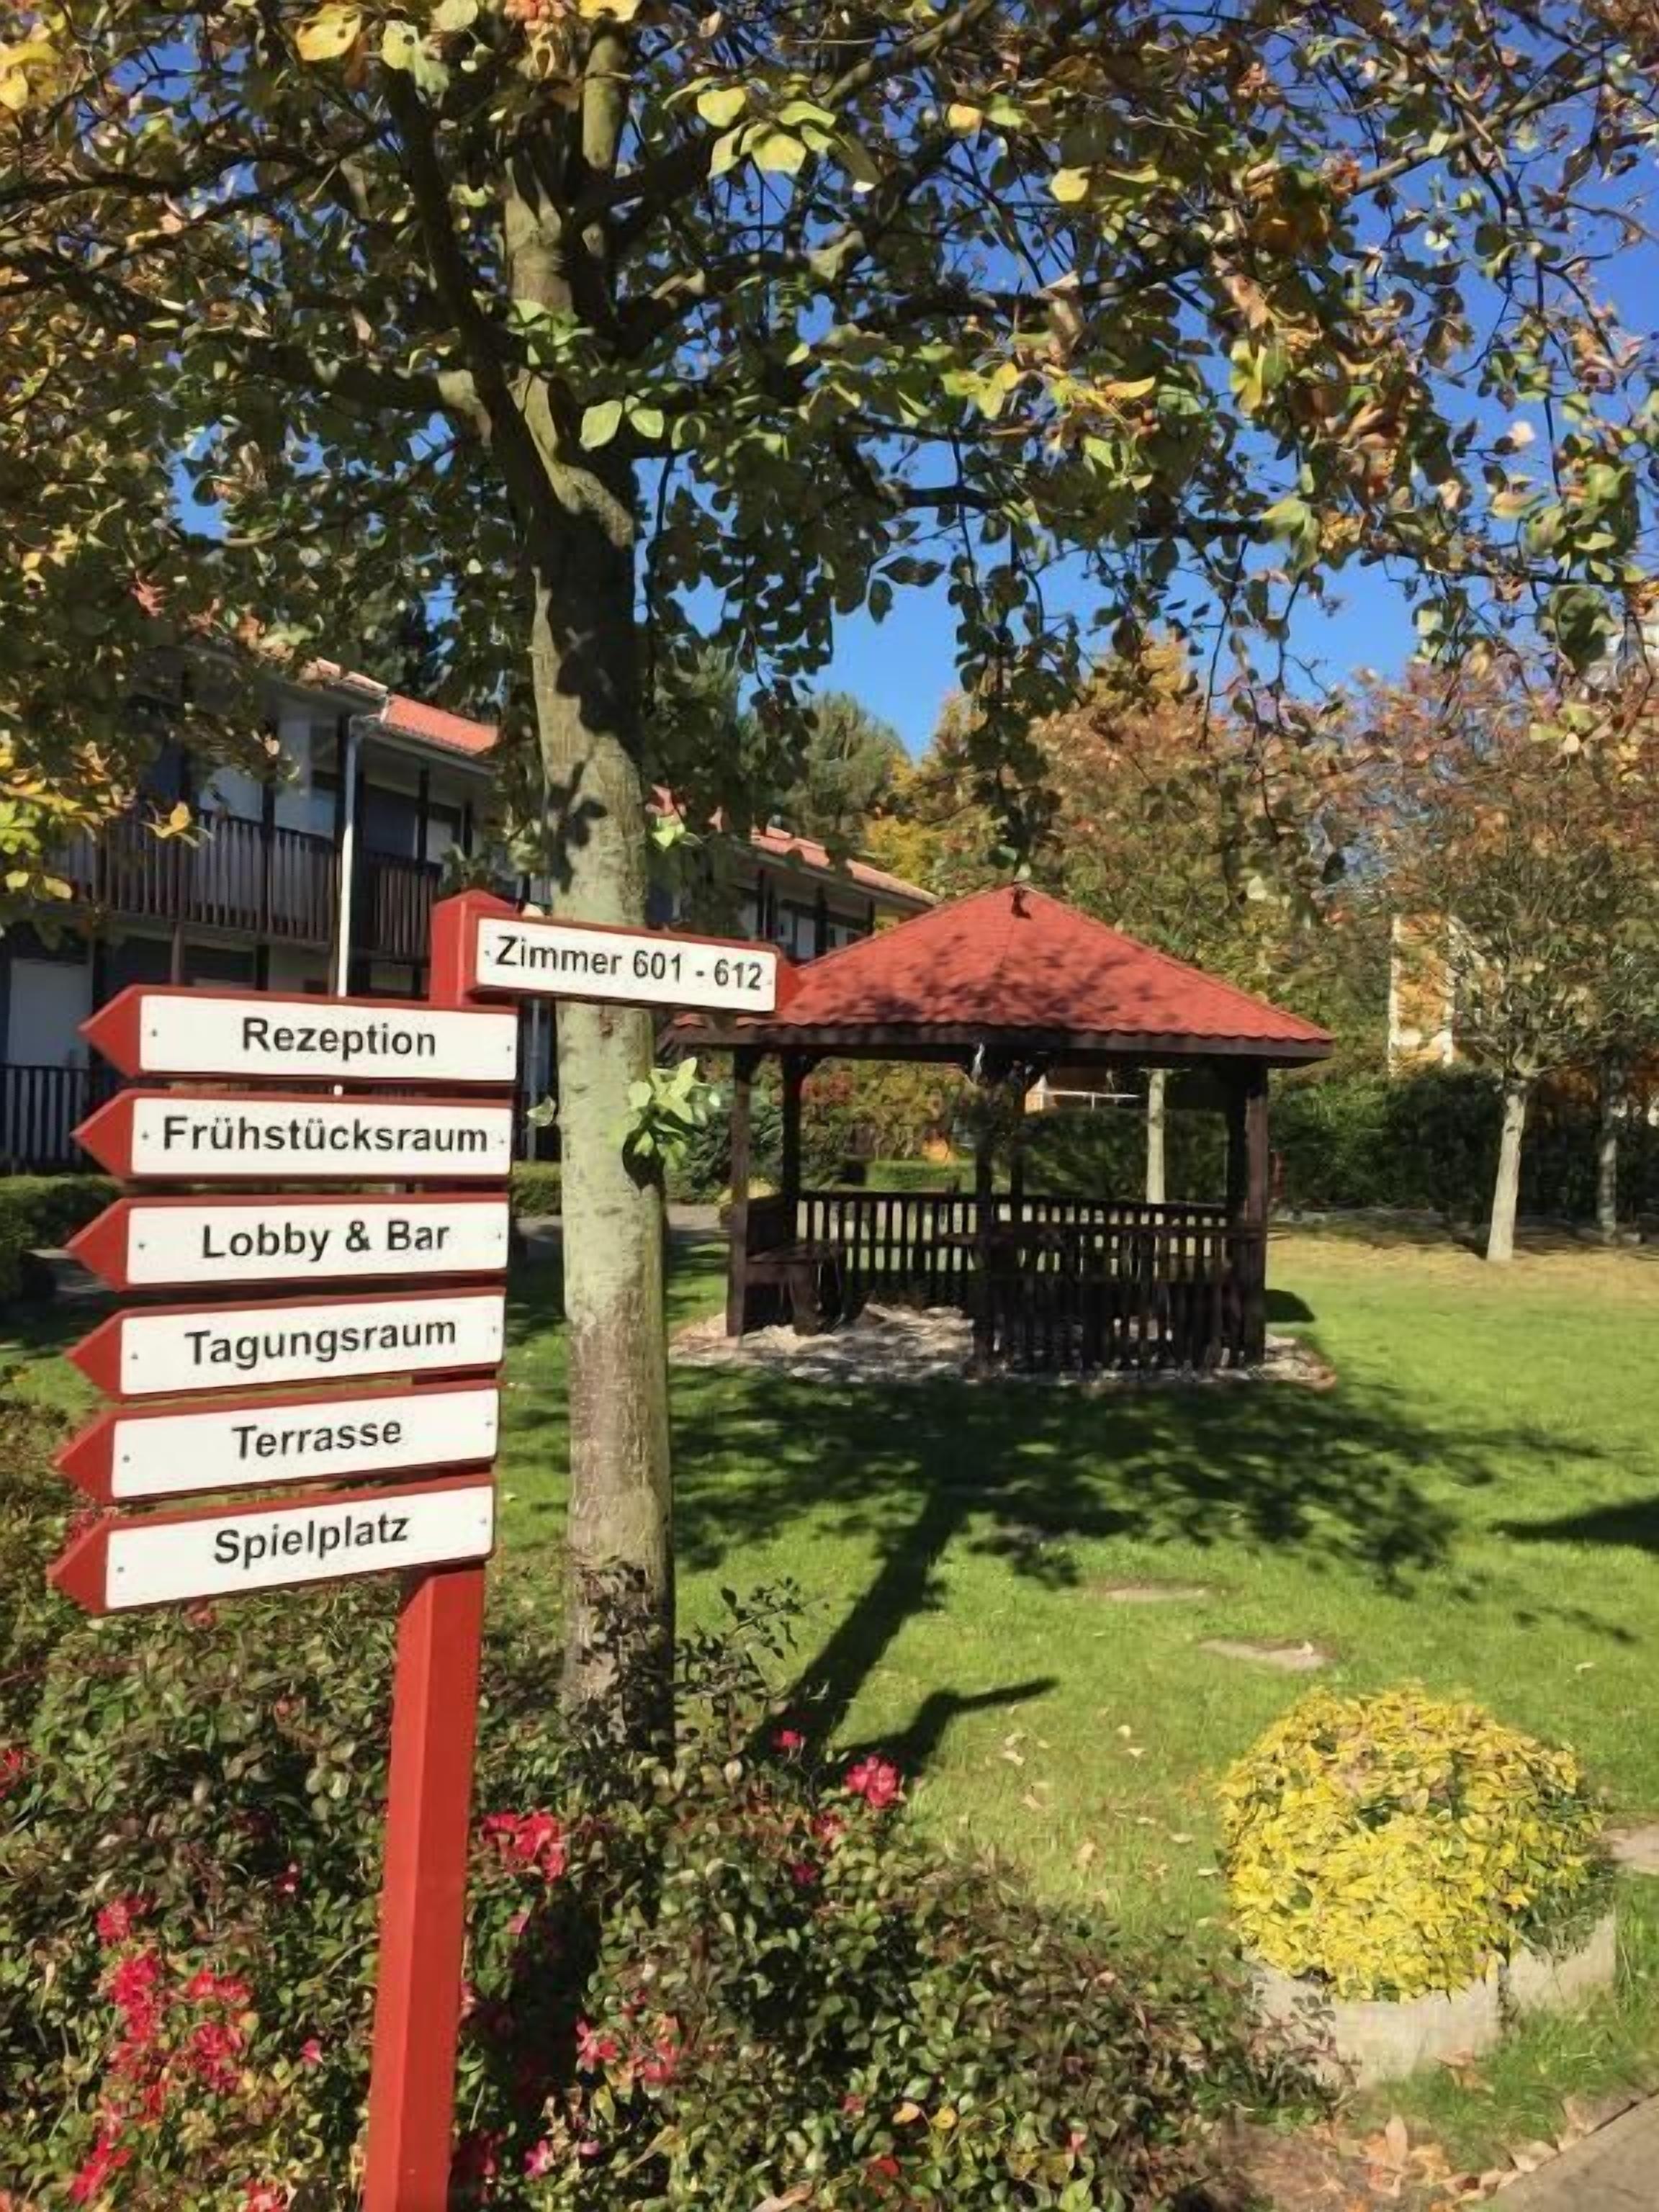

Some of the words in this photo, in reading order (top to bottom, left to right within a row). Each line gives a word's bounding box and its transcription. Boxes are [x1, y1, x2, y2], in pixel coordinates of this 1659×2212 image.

[495, 935, 622, 975] Zimmer
[633, 950, 682, 982] 601
[714, 958, 763, 991] 612
[243, 1017, 436, 1062] Rezeption
[163, 1115, 487, 1152] Frühstücksraum
[202, 1223, 331, 1262] Lobby
[345, 1220, 372, 1253] &
[387, 1220, 450, 1251] Bar
[184, 1320, 456, 1370] Tagungsraum
[231, 1421, 401, 1460] Terrasse
[213, 1513, 411, 1569] Spielplatz
